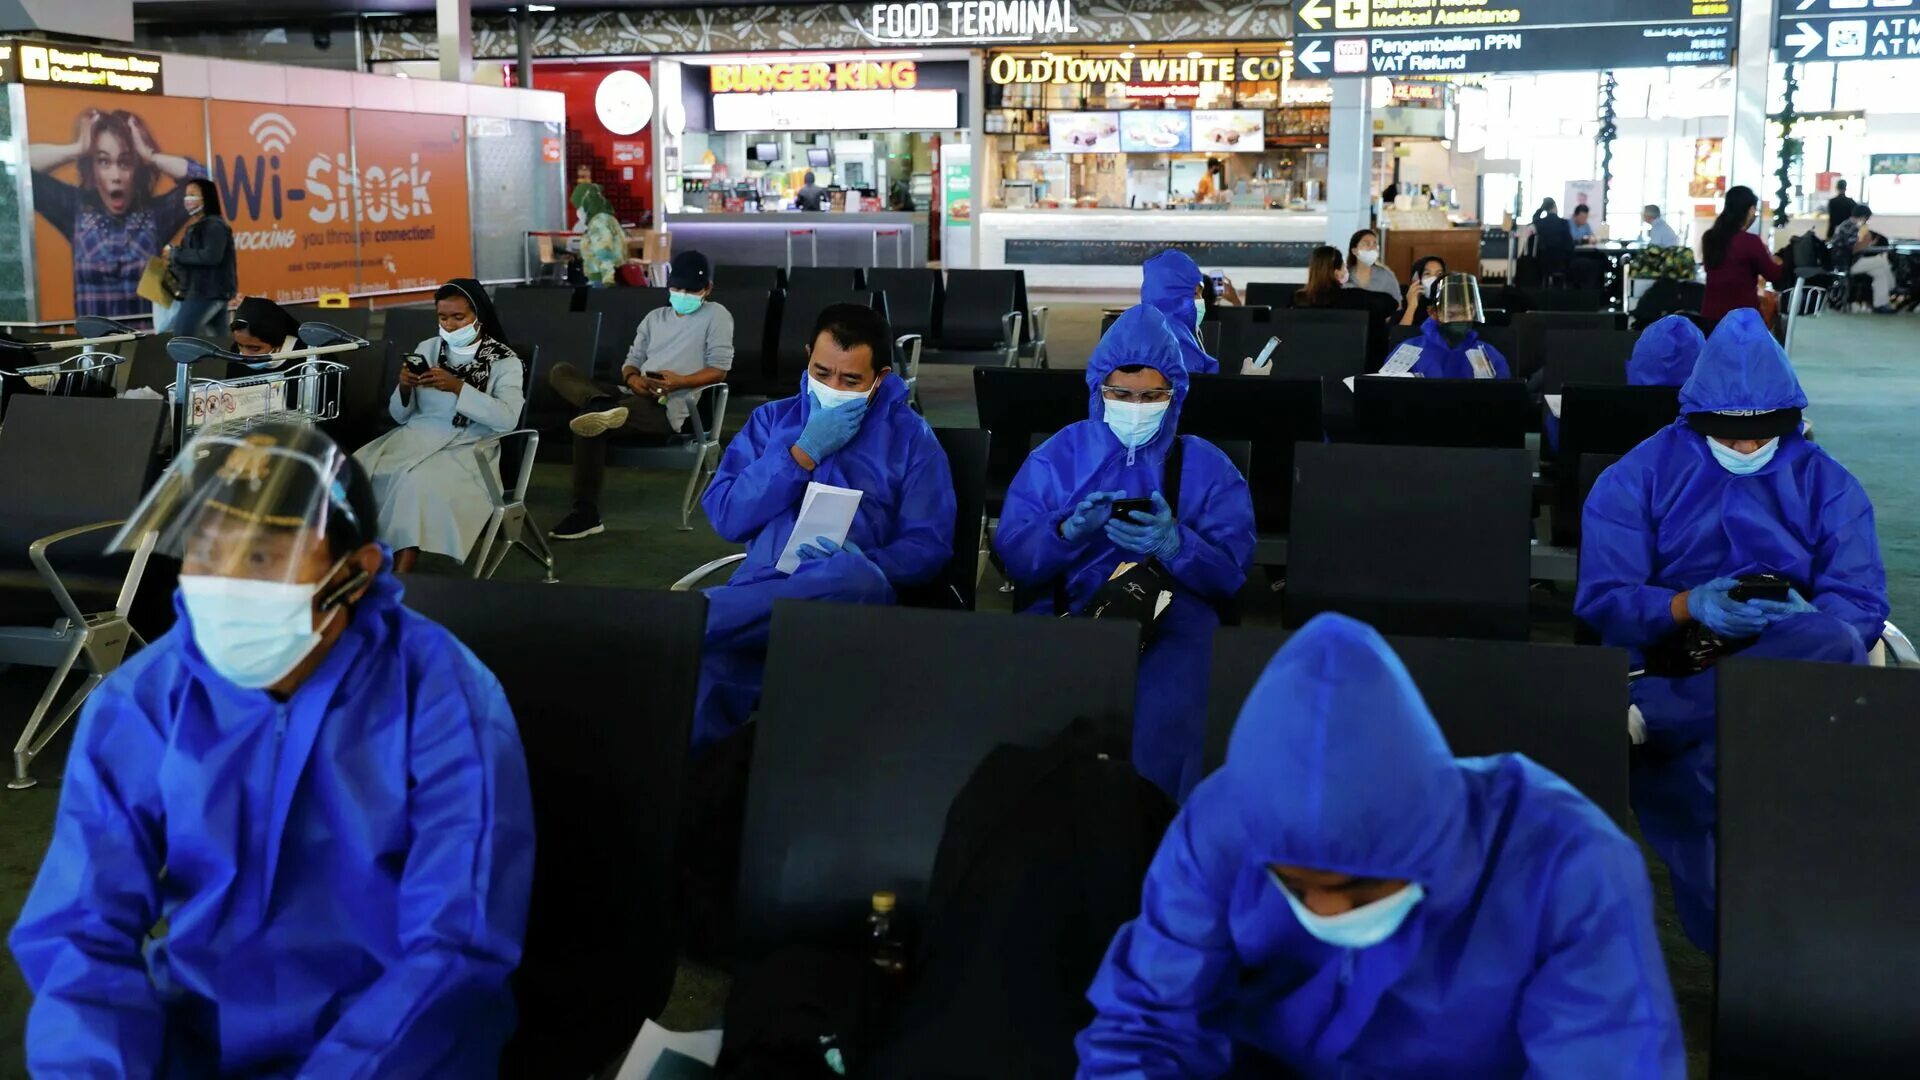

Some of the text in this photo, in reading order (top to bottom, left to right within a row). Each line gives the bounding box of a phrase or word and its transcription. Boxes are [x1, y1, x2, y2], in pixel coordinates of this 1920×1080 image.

[872, 0, 1079, 38] FOOD TERMINAL
[1372, 8, 1521, 27] Medical Assistance
[1872, 18, 1920, 36] ATM
[1371, 33, 1522, 57] Pengembalian PPN
[1871, 38, 1920, 56] ATM
[1139, 57, 1235, 82] WHITE
[1372, 53, 1466, 72] VAT Refund
[710, 60, 918, 93] BURGER KING
[303, 232, 324, 249] you
